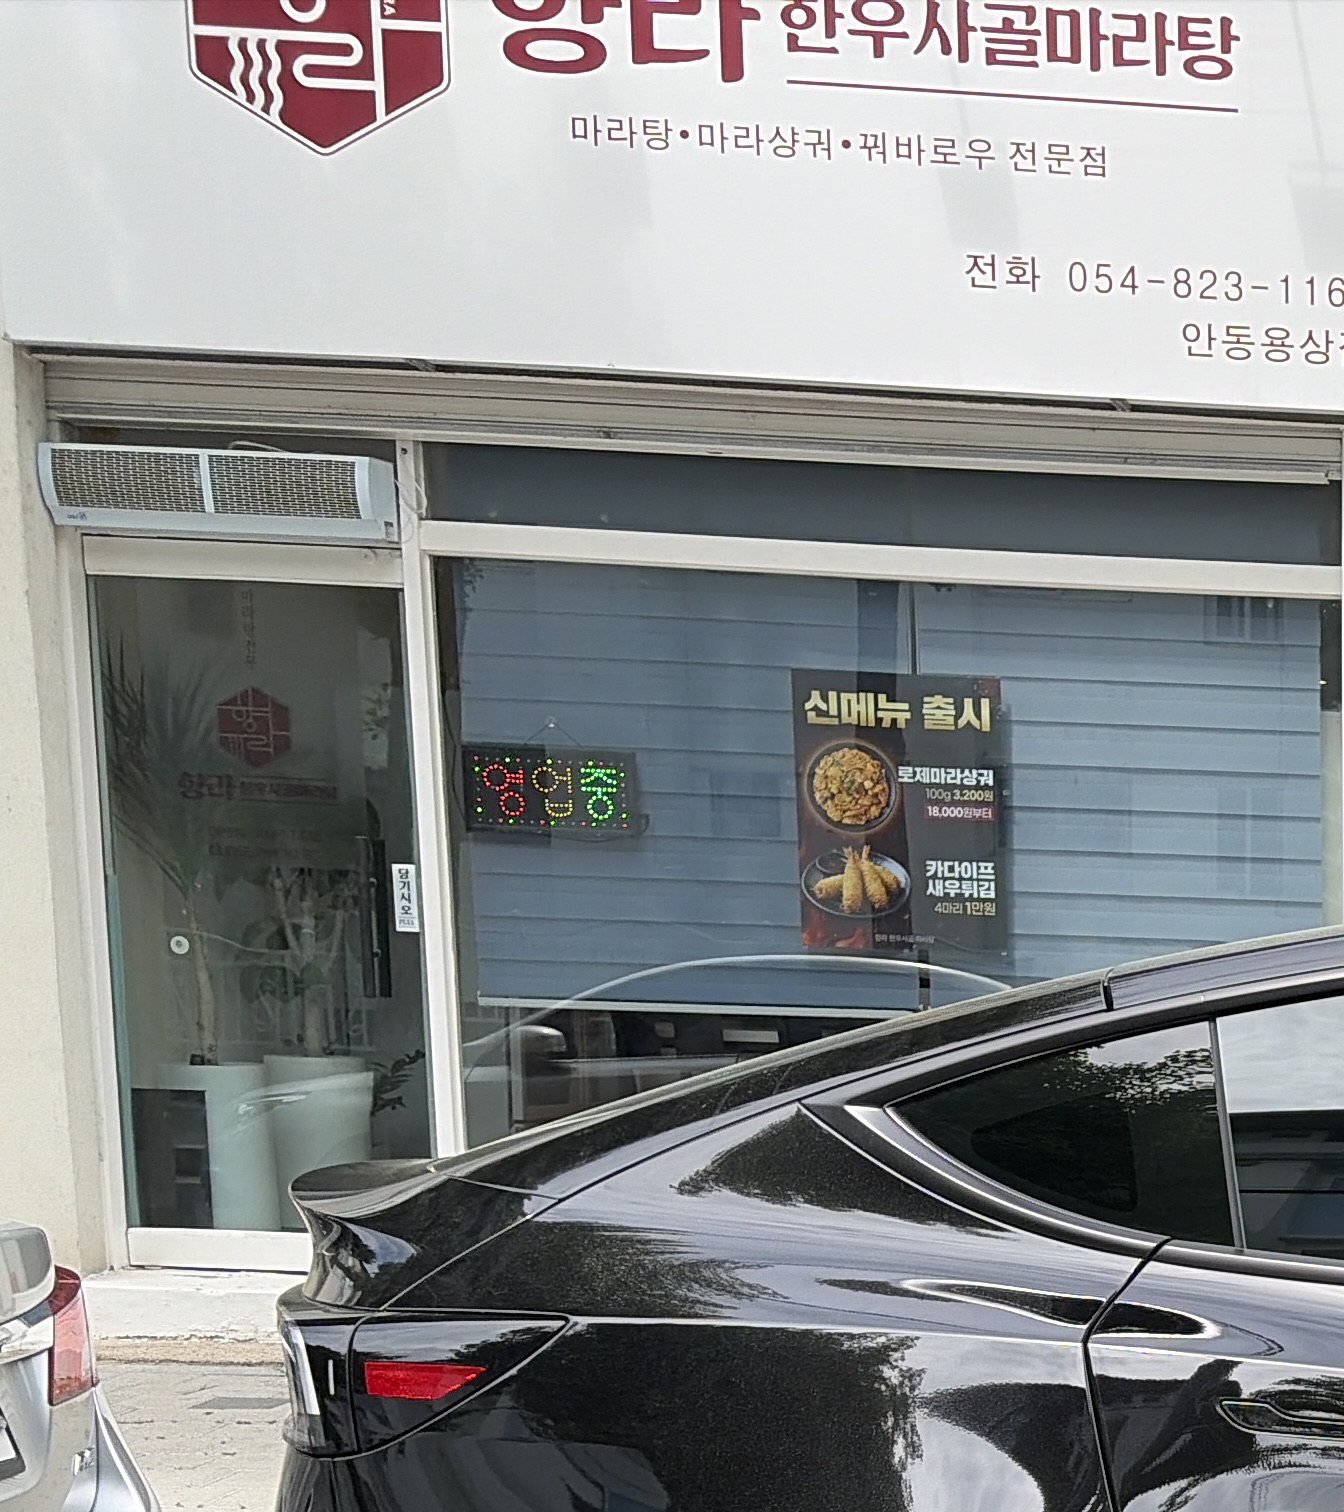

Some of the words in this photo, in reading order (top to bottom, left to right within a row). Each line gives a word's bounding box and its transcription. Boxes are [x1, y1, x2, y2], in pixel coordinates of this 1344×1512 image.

[780, 0, 1240, 80] 한우사골마라탕
[1008, 139, 1108, 178] 전문점
[964, 253, 1041, 292] 전화
[804, 690, 911, 728] 신메뉴
[922, 695, 991, 732] 출시
[482, 763, 618, 821] 영업중
[898, 766, 994, 786] 로제마라샹궈
[925, 788, 951, 802] 100g
[925, 860, 996, 879] 카다이프
[926, 879, 996, 899] 새우튀김
[398, 868, 412, 915] 당기시오
[934, 902, 963, 914] 4마리
[965, 902, 996, 915] 1만원
